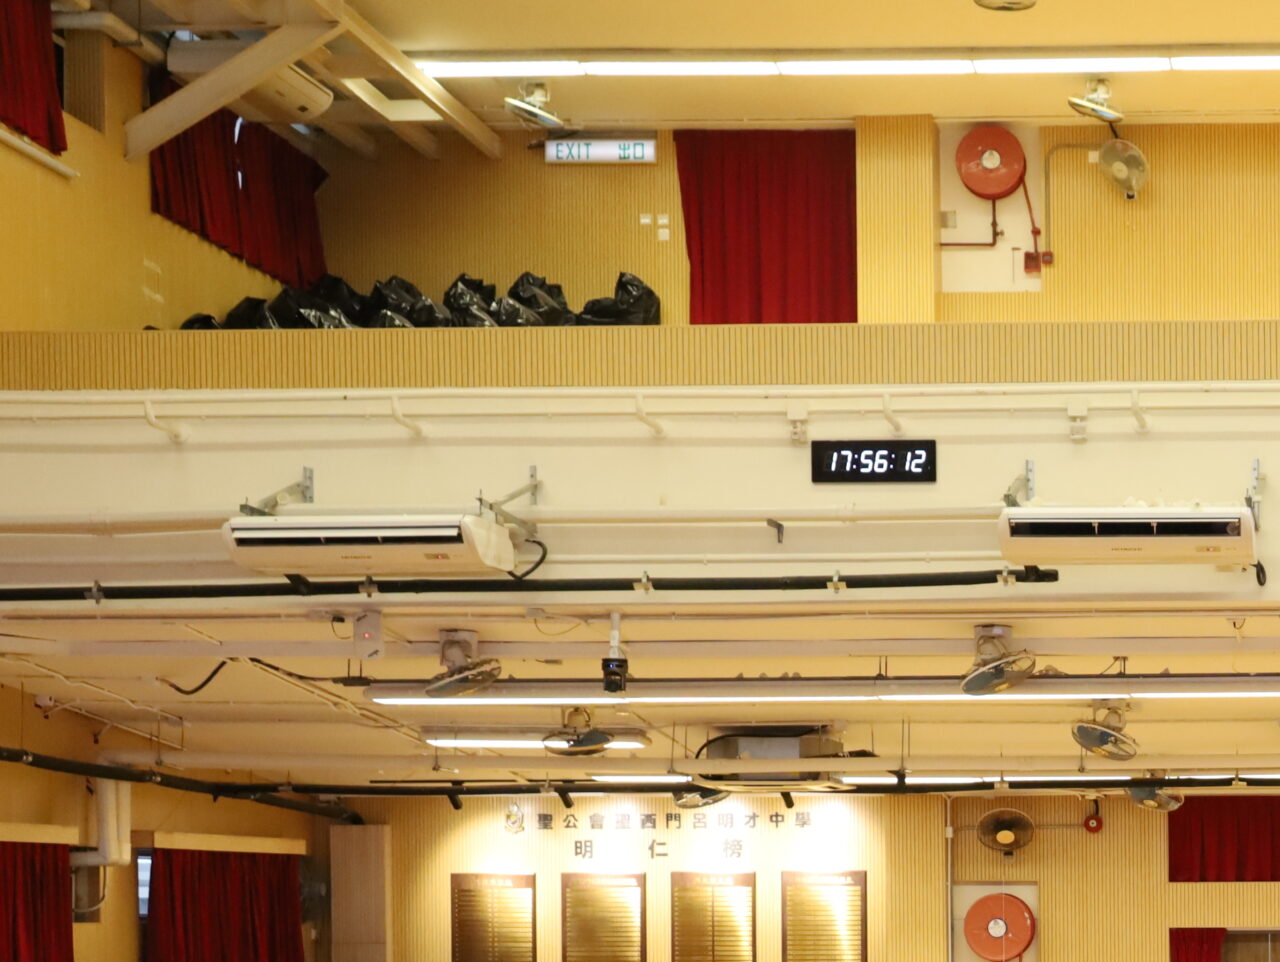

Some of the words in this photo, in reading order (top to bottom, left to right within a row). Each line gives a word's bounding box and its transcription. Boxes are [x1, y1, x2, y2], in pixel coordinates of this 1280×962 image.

[556, 143, 592, 160] EXIT
[618, 142, 645, 160] 出口
[831, 450, 927, 473] 17:56:12
[537, 812, 812, 830] 聖公會聖西門呂明才中學
